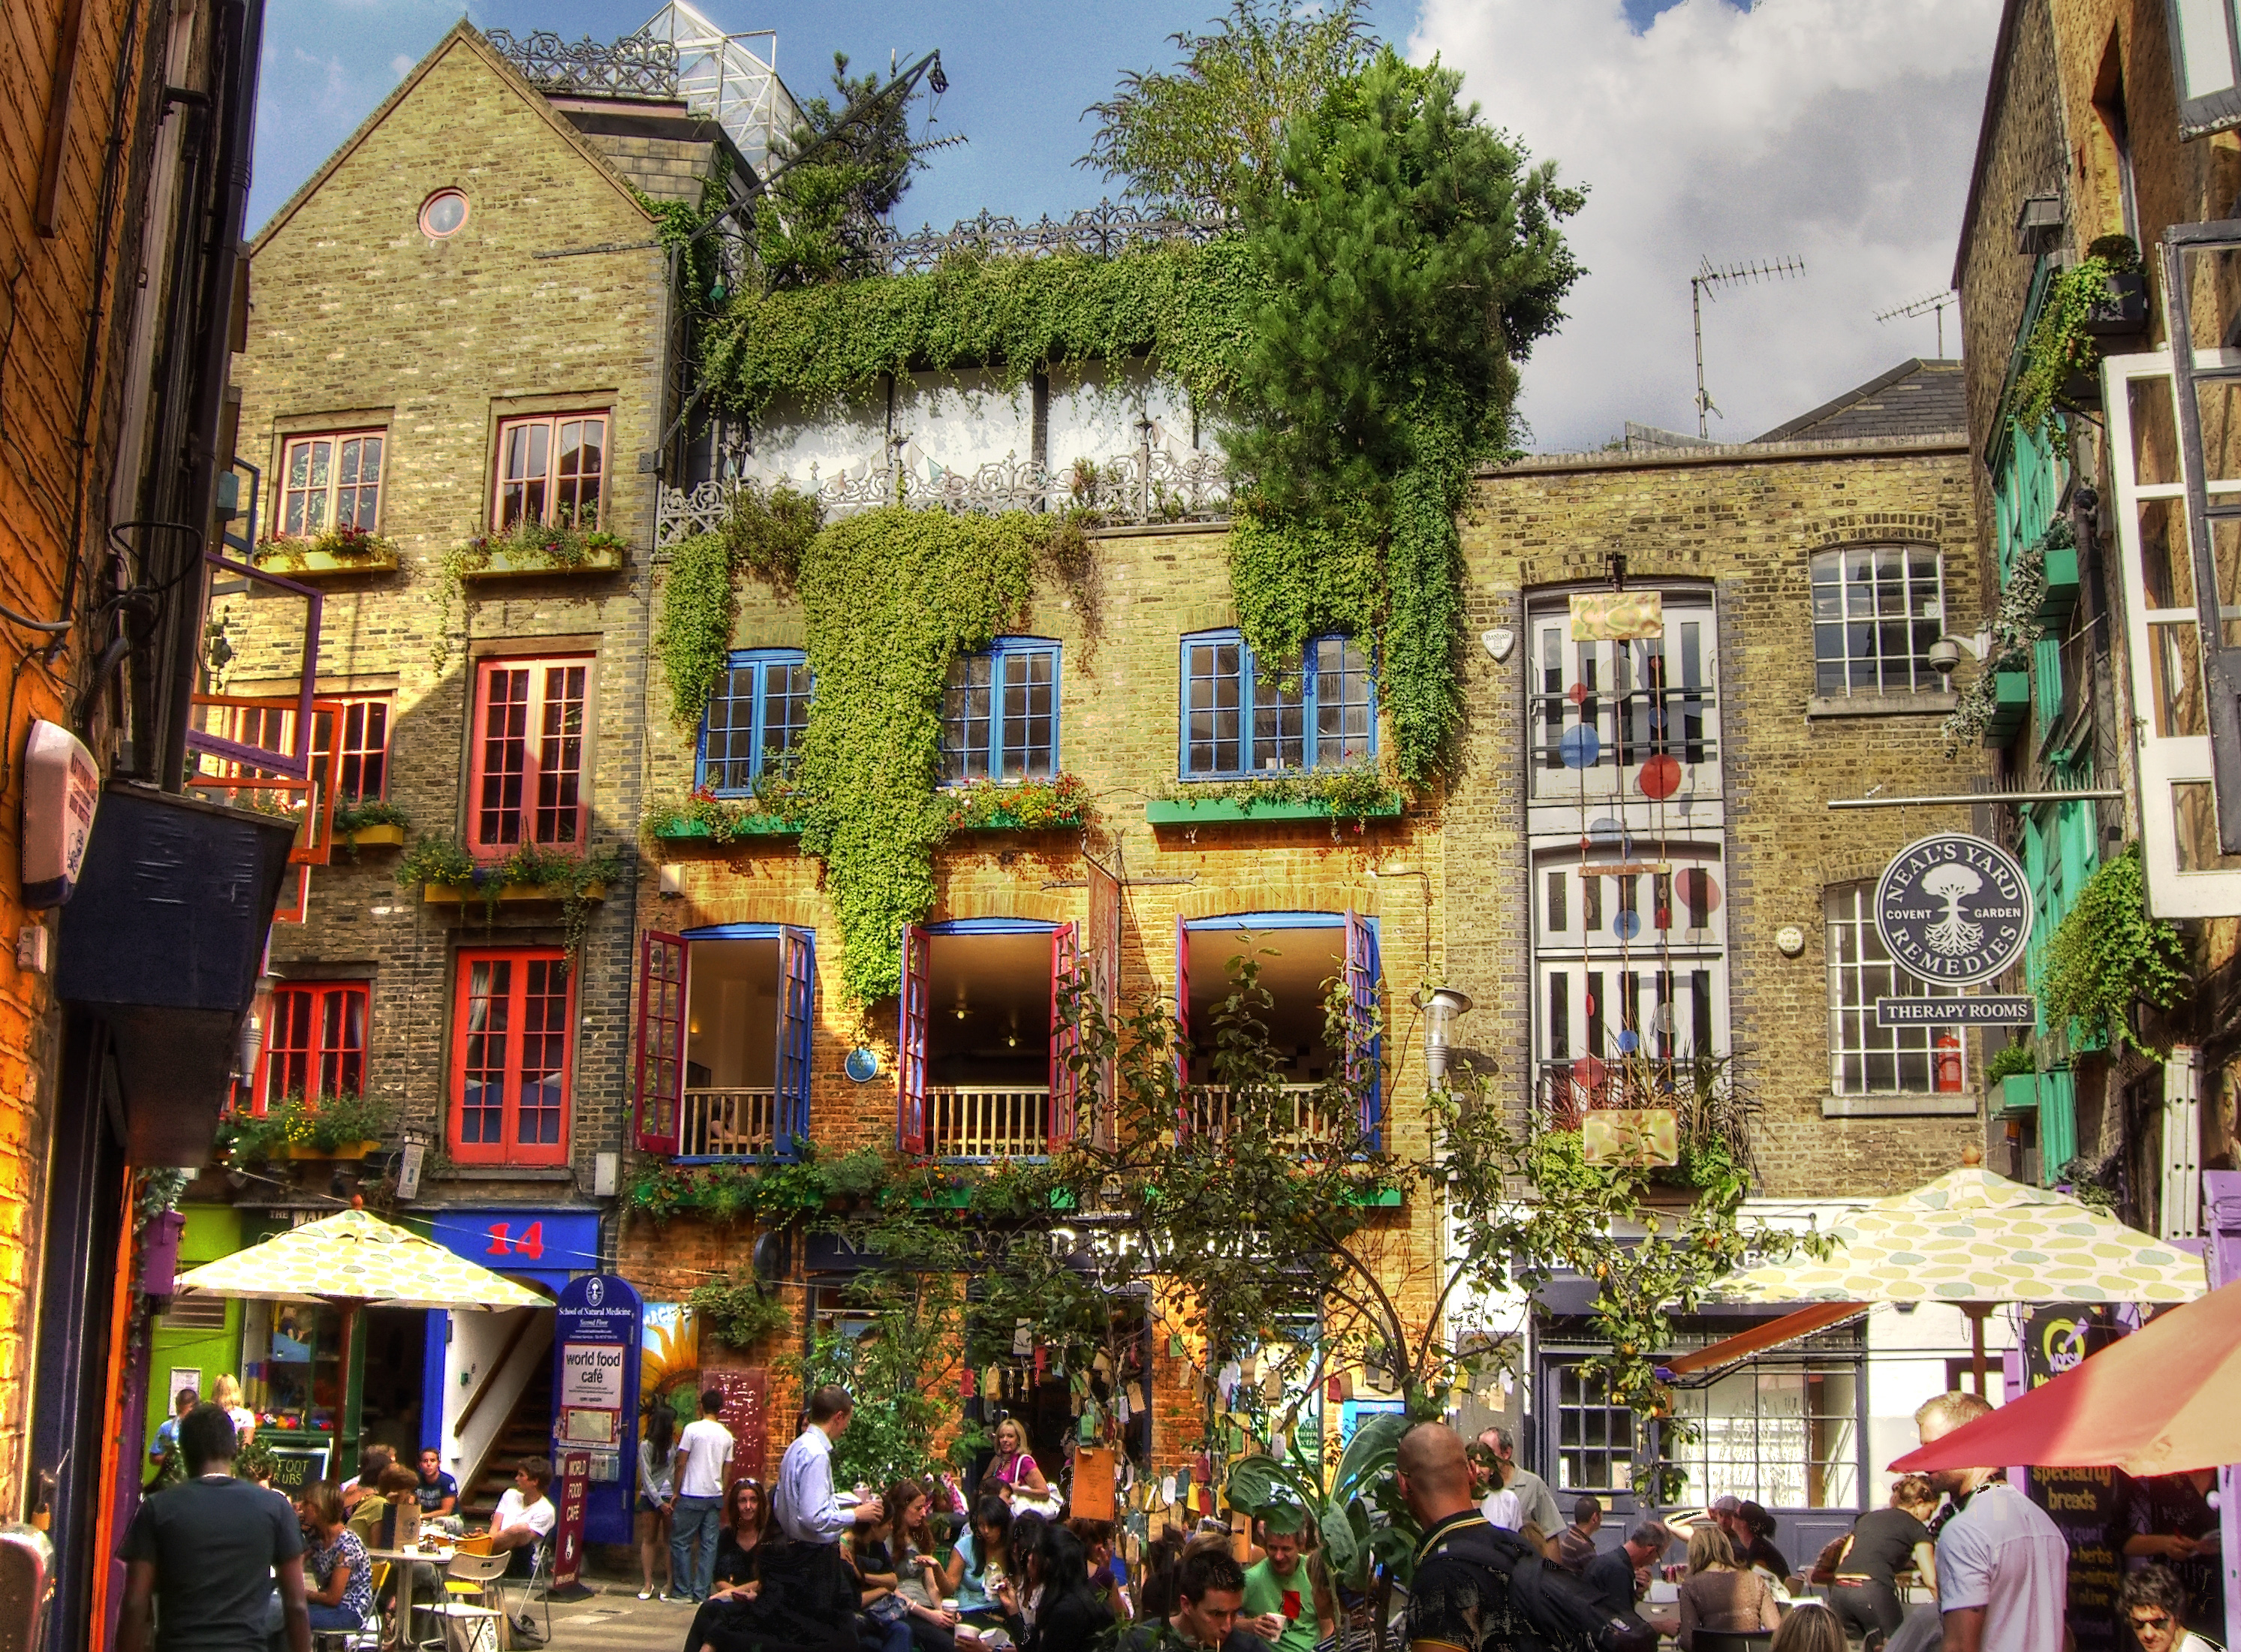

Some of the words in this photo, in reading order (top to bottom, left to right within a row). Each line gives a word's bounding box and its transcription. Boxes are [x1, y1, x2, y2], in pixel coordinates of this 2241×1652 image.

[1886, 843, 1958, 904] NEAL'S
[1964, 845, 2020, 901] YARD
[1886, 909, 1932, 920] COVENT
[1974, 907, 2021, 919] GARDEN
[1891, 923, 2018, 976] REMEDIES
[1886, 1004, 1967, 1019] THERAPY
[1969, 1002, 2028, 1018] ROOMS
[270, 1210, 290, 1220] THE
[486, 1221, 544, 1260] 14
[558, 1307, 577, 1316] School
[577, 1307, 584, 1316] of
[584, 1307, 605, 1316] Natural
[605, 1307, 632, 1316] Medicine
[566, 1352, 595, 1366] world
[597, 1352, 621, 1367] food
[582, 1368, 604, 1384] café
[276, 1459, 309, 1473] FOOT
[568, 1460, 587, 1477] WORLD
[273, 1473, 303, 1485] RUBS
[568, 1482, 583, 1500] FOOD
[2047, 1486, 2097, 1512] breads
[566, 1503, 580, 1522] CAFÉ
